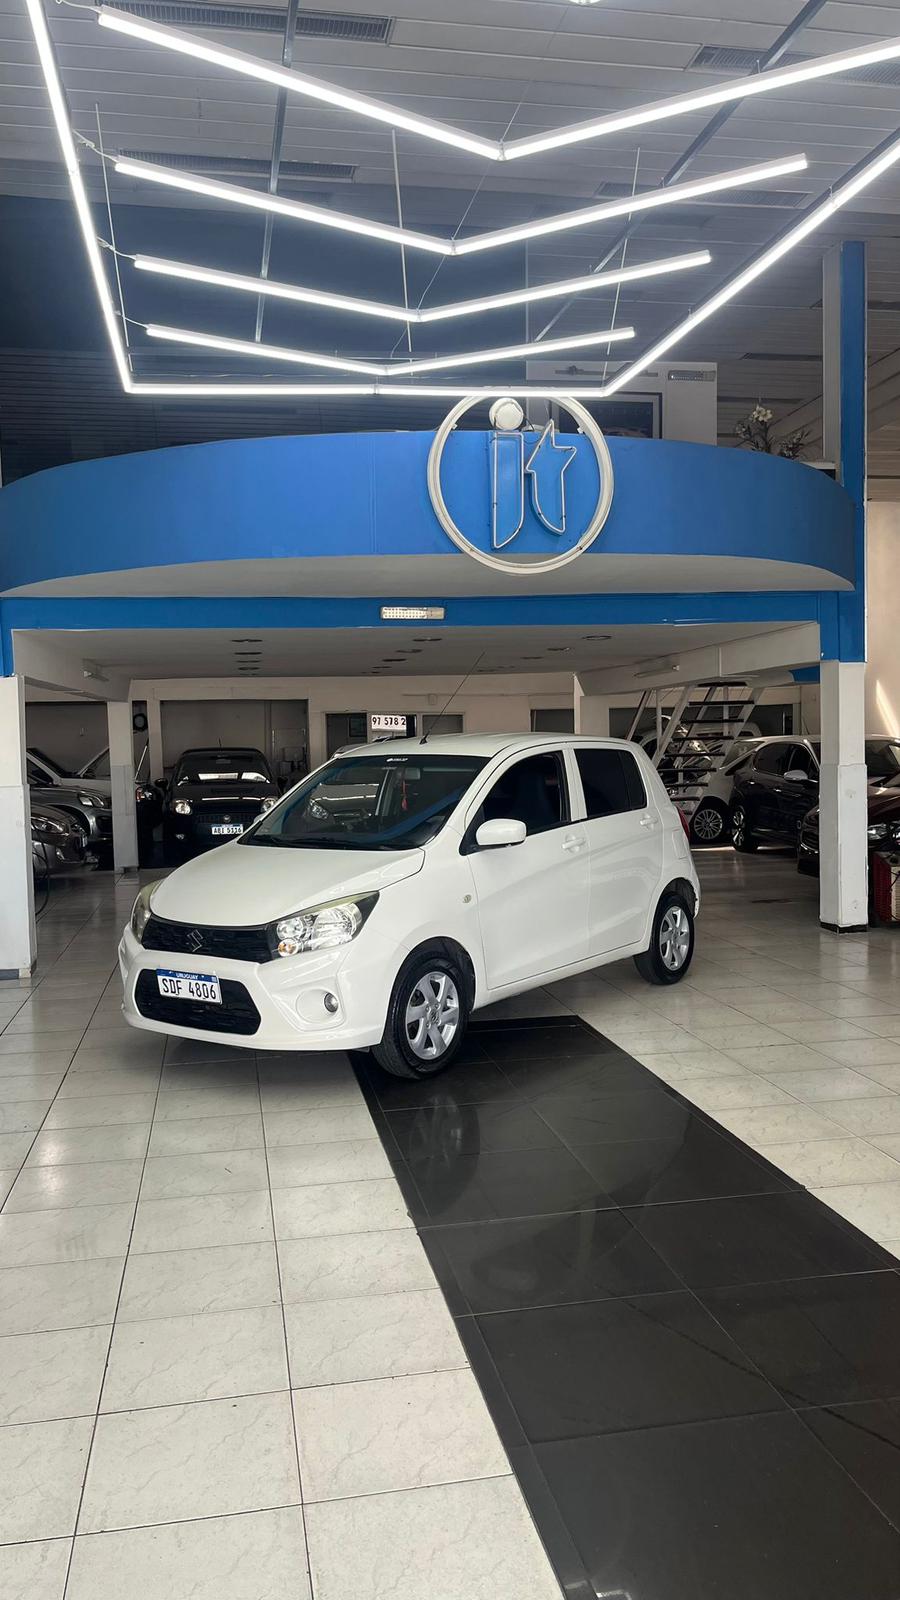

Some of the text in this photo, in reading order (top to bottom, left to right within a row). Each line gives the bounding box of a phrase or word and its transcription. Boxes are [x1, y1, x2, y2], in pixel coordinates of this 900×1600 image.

[176, 972, 198, 980] URUGUAY
[162, 978, 216, 999] SDF 4806
